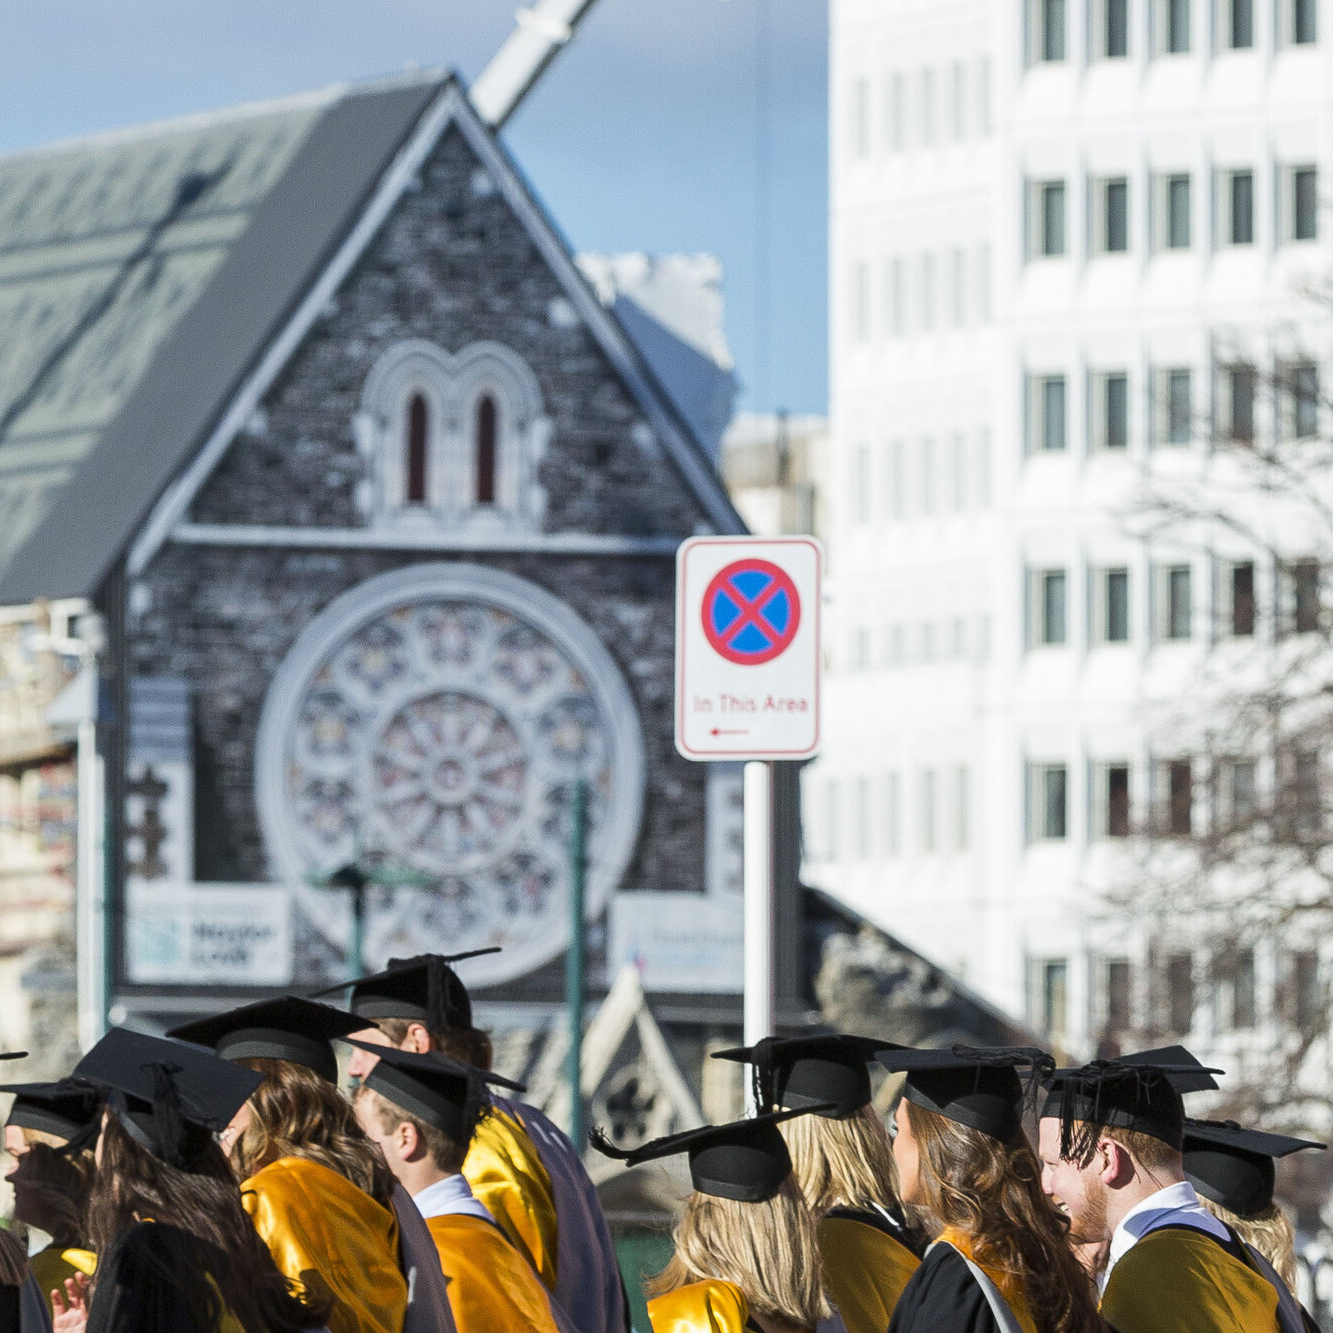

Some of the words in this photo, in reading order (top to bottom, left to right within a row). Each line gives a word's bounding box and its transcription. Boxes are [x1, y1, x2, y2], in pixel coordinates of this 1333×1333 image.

[693, 695, 713, 712] In
[720, 694, 756, 713] This
[763, 694, 809, 713] Area
